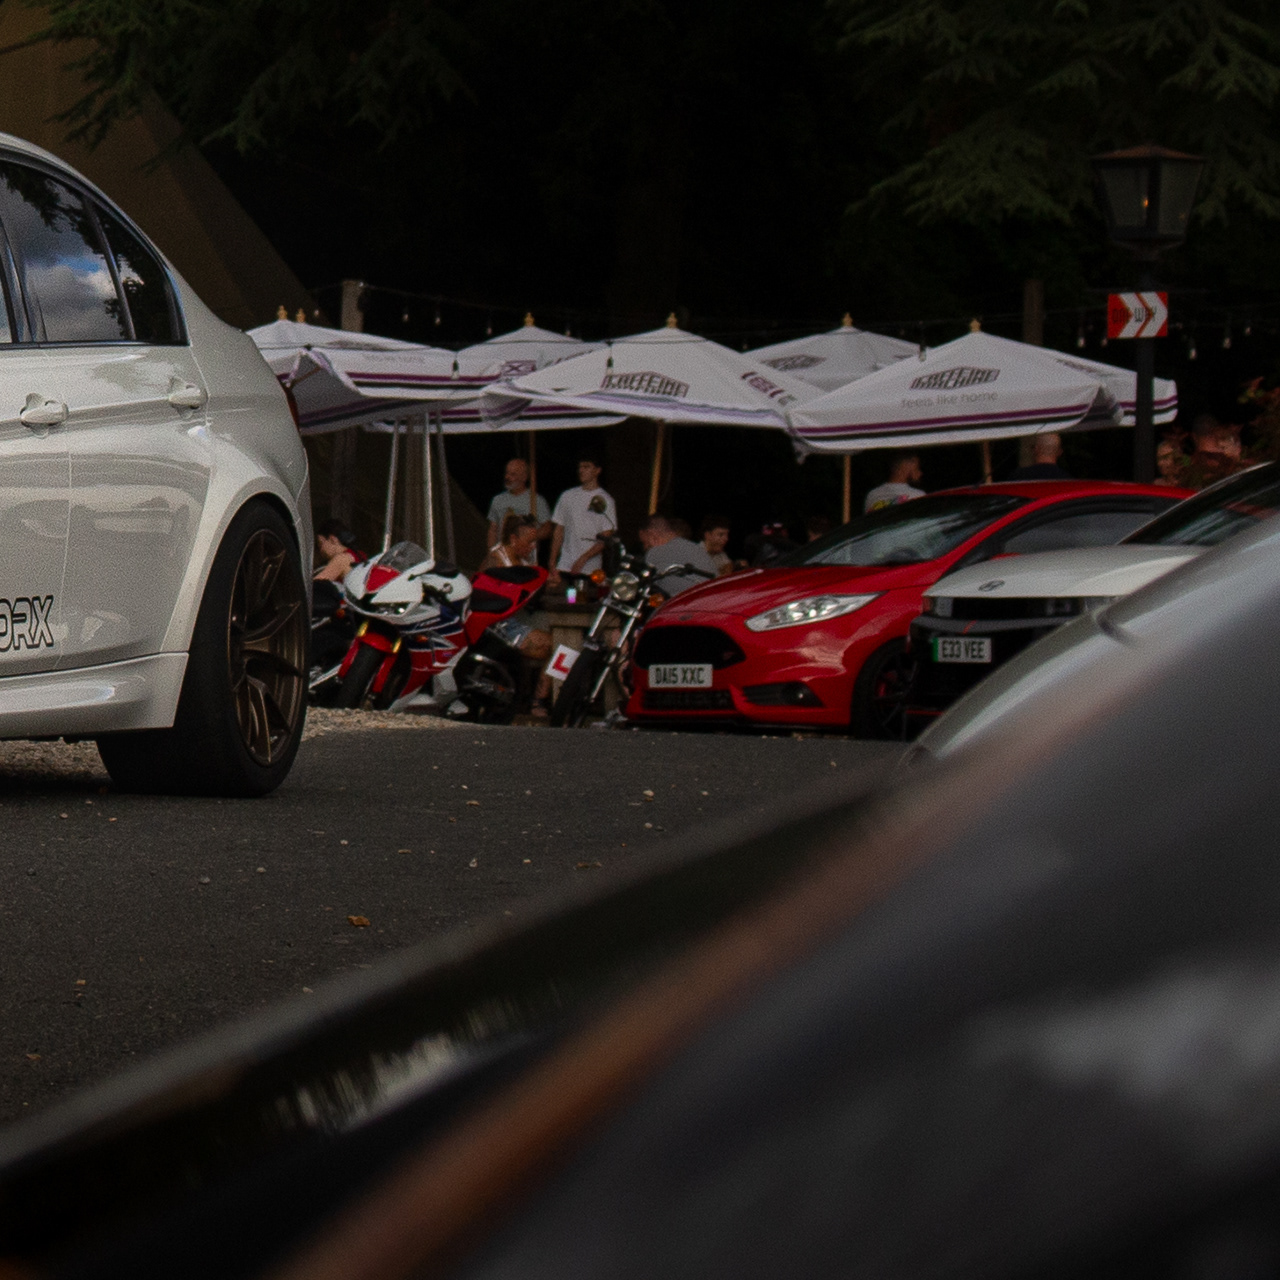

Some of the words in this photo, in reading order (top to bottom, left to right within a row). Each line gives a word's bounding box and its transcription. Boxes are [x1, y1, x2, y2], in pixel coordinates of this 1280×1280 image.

[941, 639, 962, 659] E33
[964, 639, 986, 659] VEE
[655, 667, 679, 684] DA15
[681, 667, 705, 684] XXC
